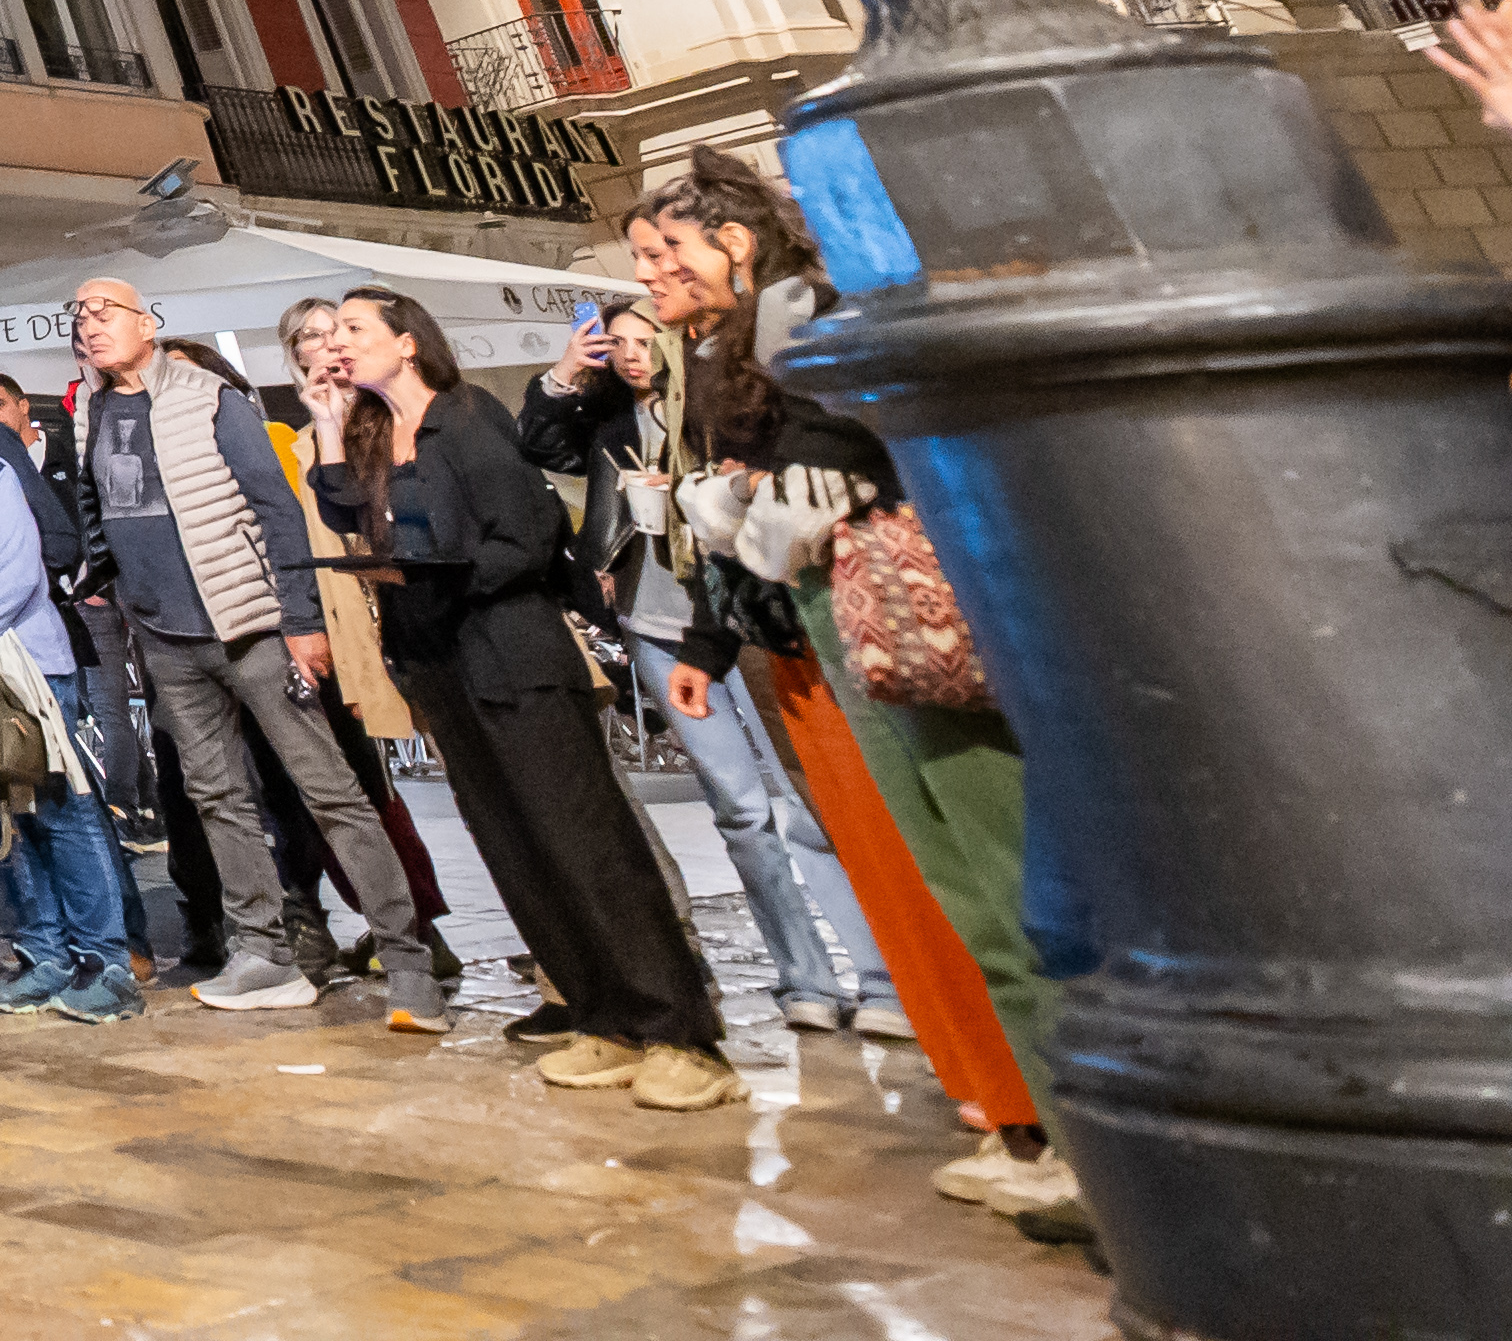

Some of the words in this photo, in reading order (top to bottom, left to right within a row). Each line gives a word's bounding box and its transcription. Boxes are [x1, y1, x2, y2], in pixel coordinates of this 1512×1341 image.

[280, 85, 624, 167] RESTAURANT
[374, 145, 598, 221] FLORIDA
[27, 311, 71, 340] DE
